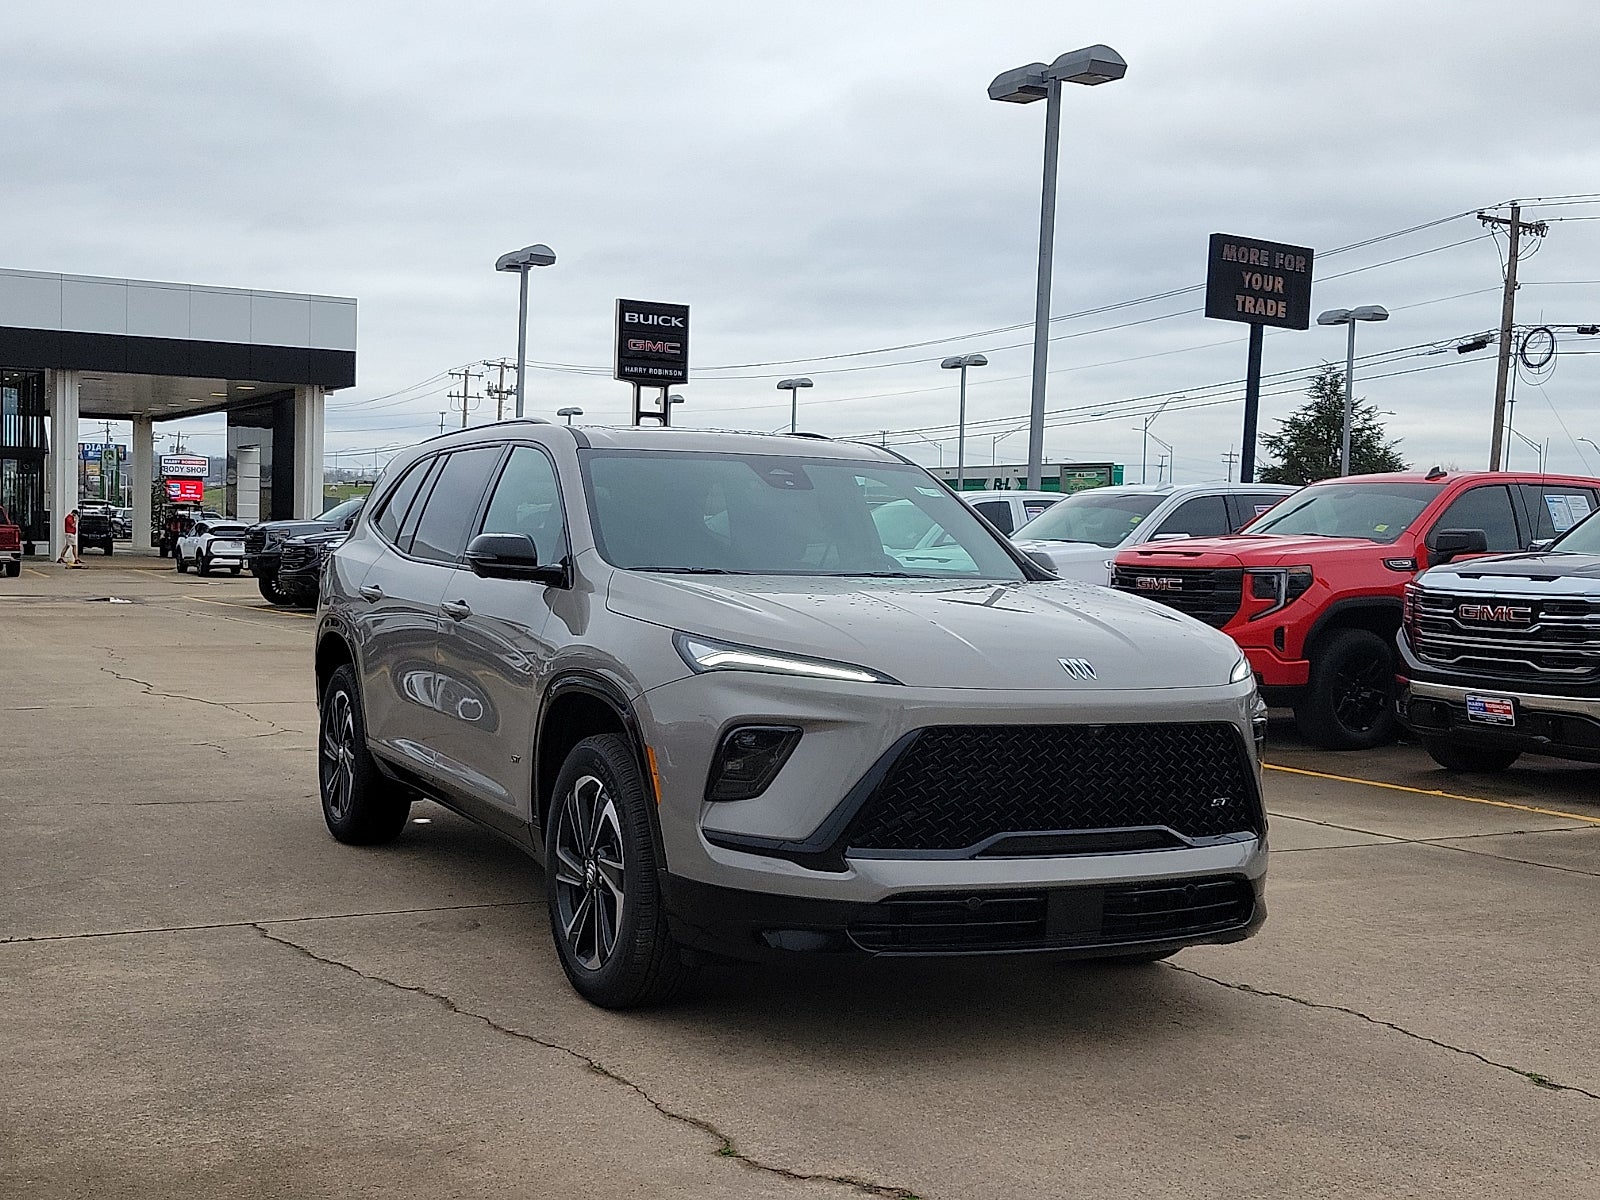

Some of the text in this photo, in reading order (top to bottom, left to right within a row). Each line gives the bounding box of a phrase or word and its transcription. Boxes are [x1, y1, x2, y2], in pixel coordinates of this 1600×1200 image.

[1222, 244, 1306, 273] MORE FOR
[1241, 271, 1284, 294] YOUR
[1235, 294, 1287, 318] TRADE
[625, 312, 685, 328] BUICK
[627, 338, 681, 354] GMC
[625, 366, 683, 377] HARRY ROBINSON
[163, 465, 207, 474] BODY SHOP
[1136, 576, 1183, 592] GMC
[1458, 603, 1532, 623] GMC
[1210, 797, 1231, 807] ST
